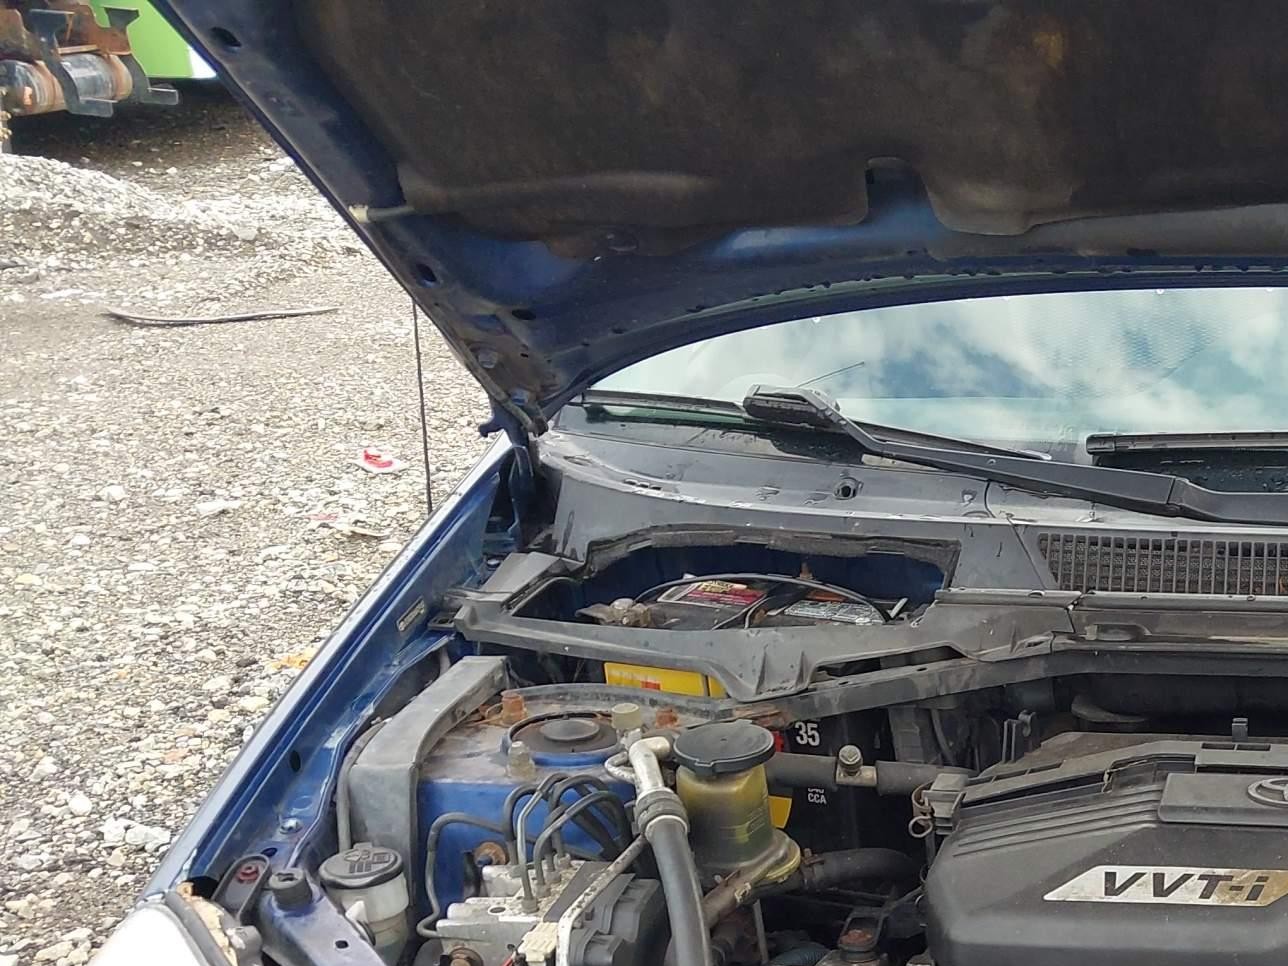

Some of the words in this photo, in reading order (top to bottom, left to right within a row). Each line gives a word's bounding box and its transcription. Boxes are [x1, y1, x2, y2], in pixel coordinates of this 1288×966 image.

[795, 722, 820, 746] 35
[807, 793, 827, 804] CCA
[1103, 871, 1269, 901] VVT-i
